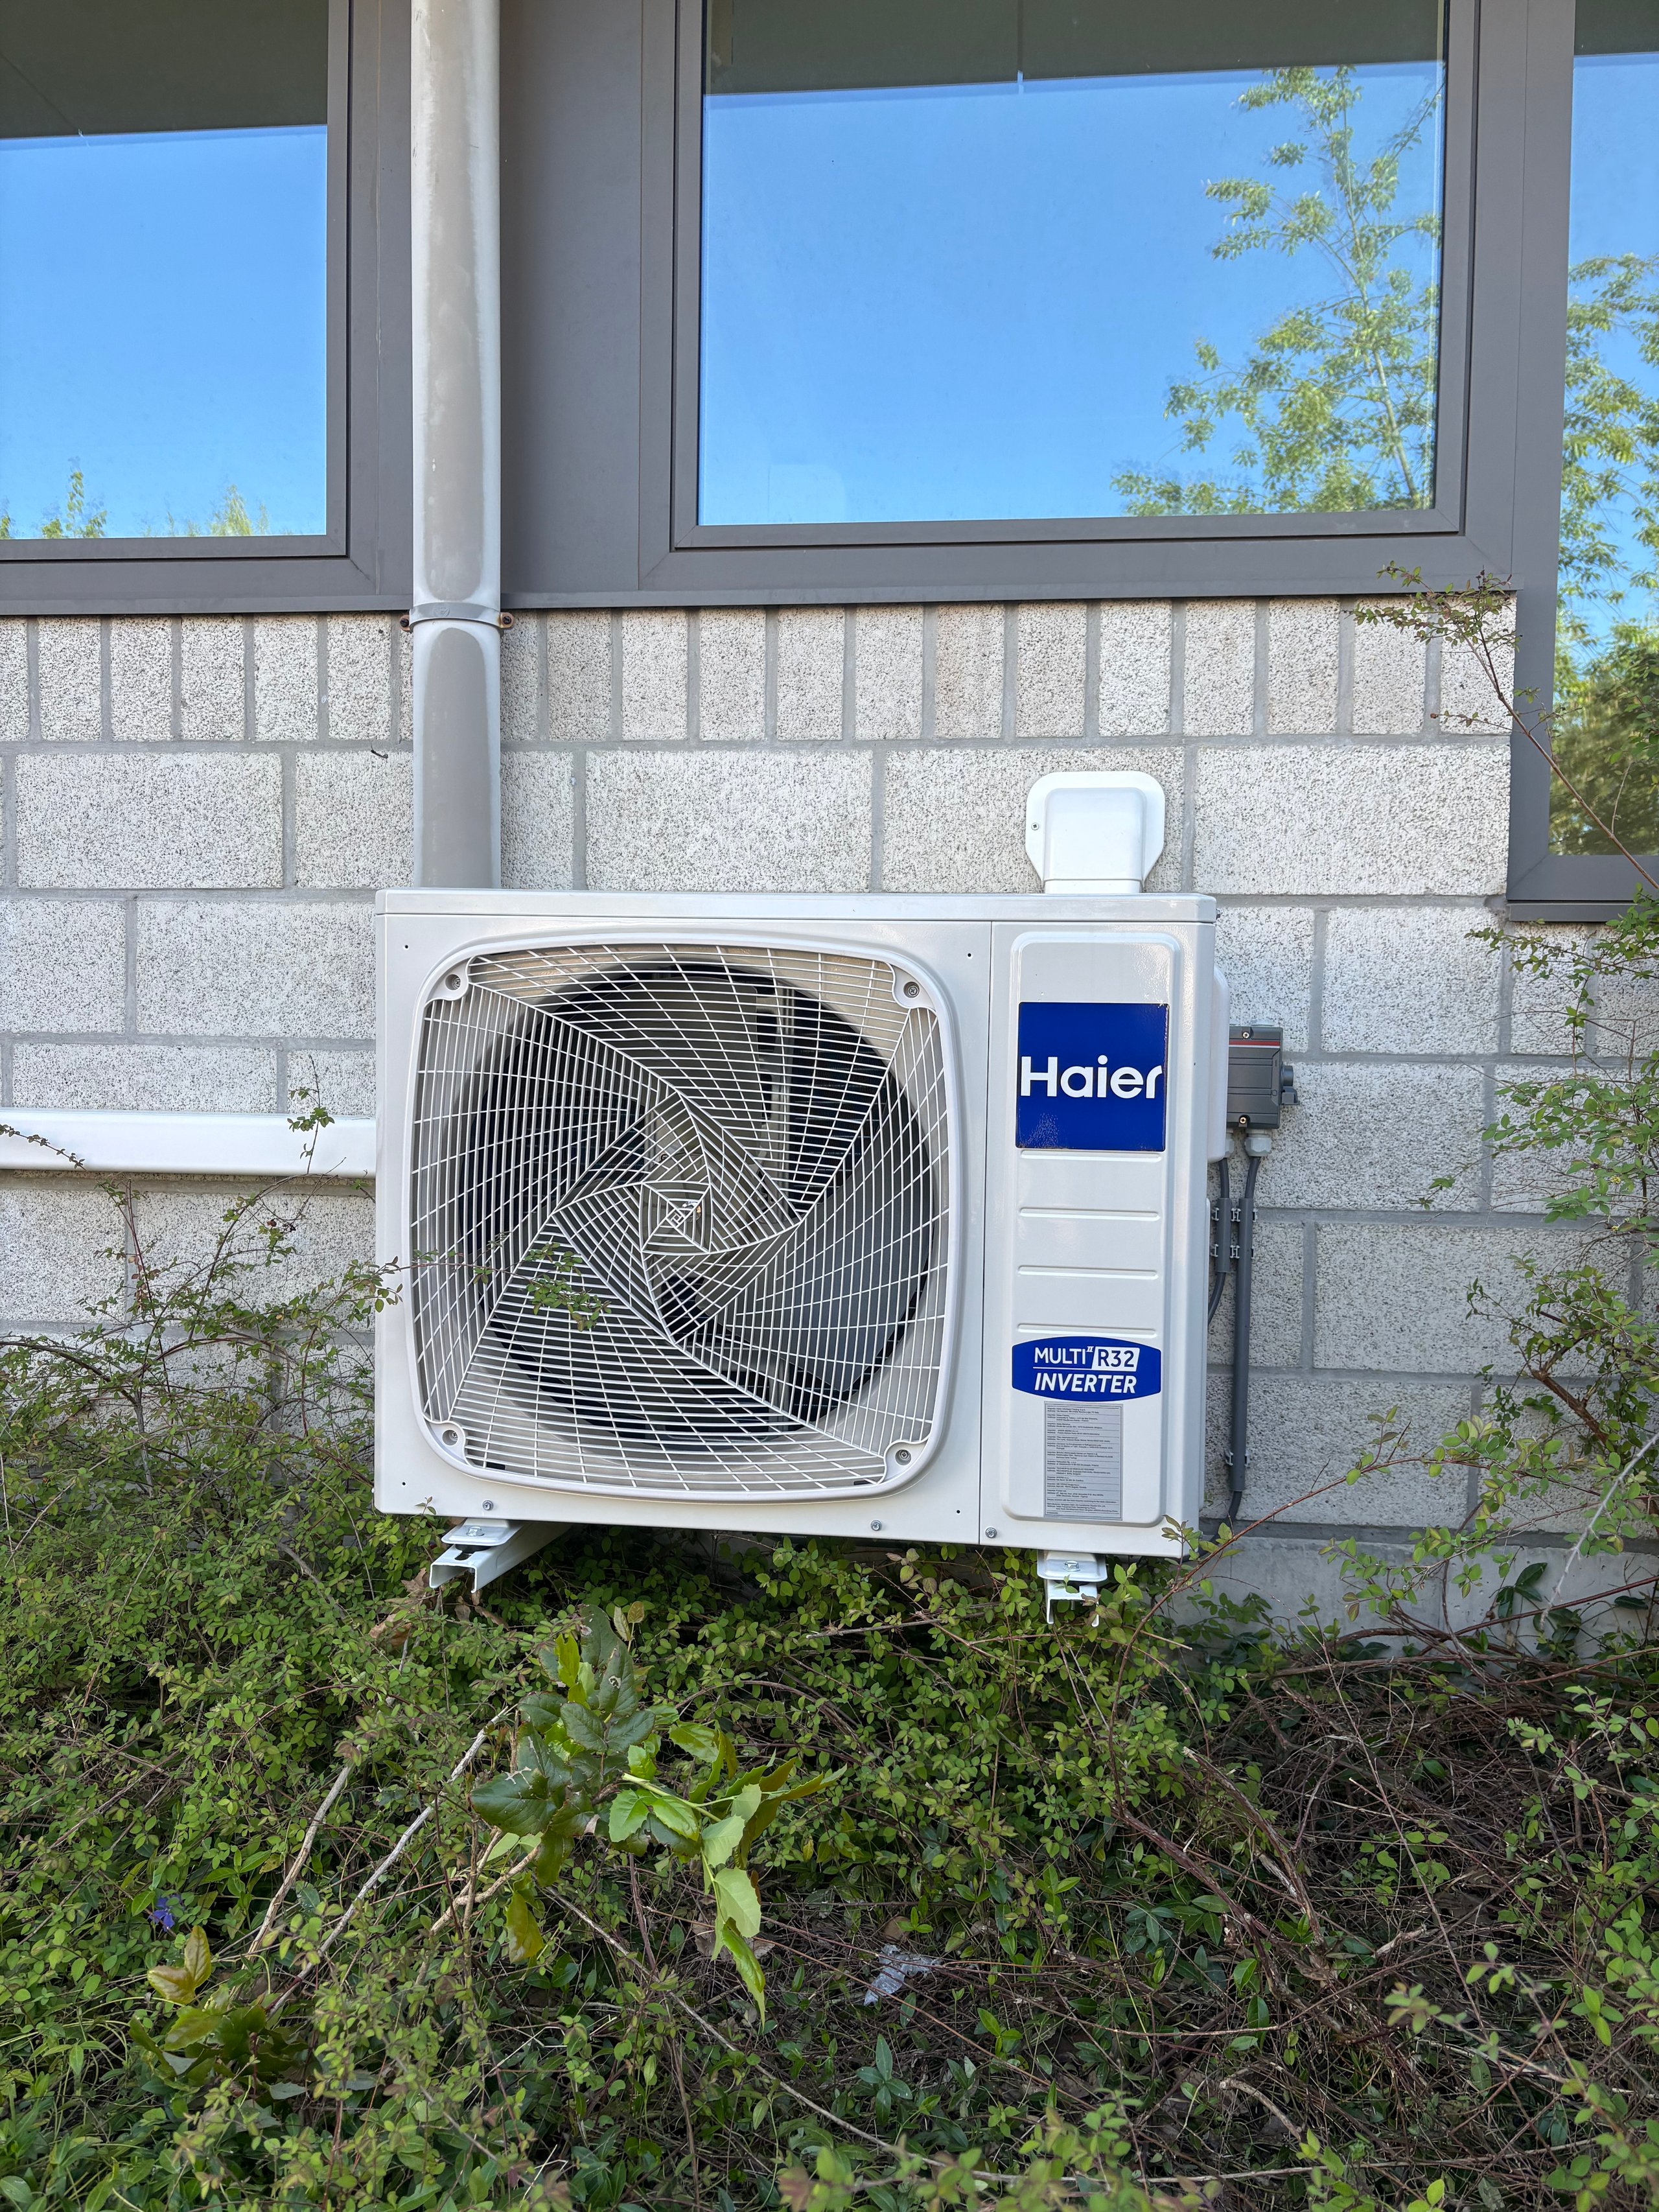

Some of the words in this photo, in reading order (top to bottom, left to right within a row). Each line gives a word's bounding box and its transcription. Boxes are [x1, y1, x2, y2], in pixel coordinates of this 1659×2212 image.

[1021, 1054, 1163, 1099] Haier
[1034, 1347, 1085, 1365] MULTI
[1098, 1349, 1134, 1368] R32
[1034, 1372, 1137, 1393] INVERTER
